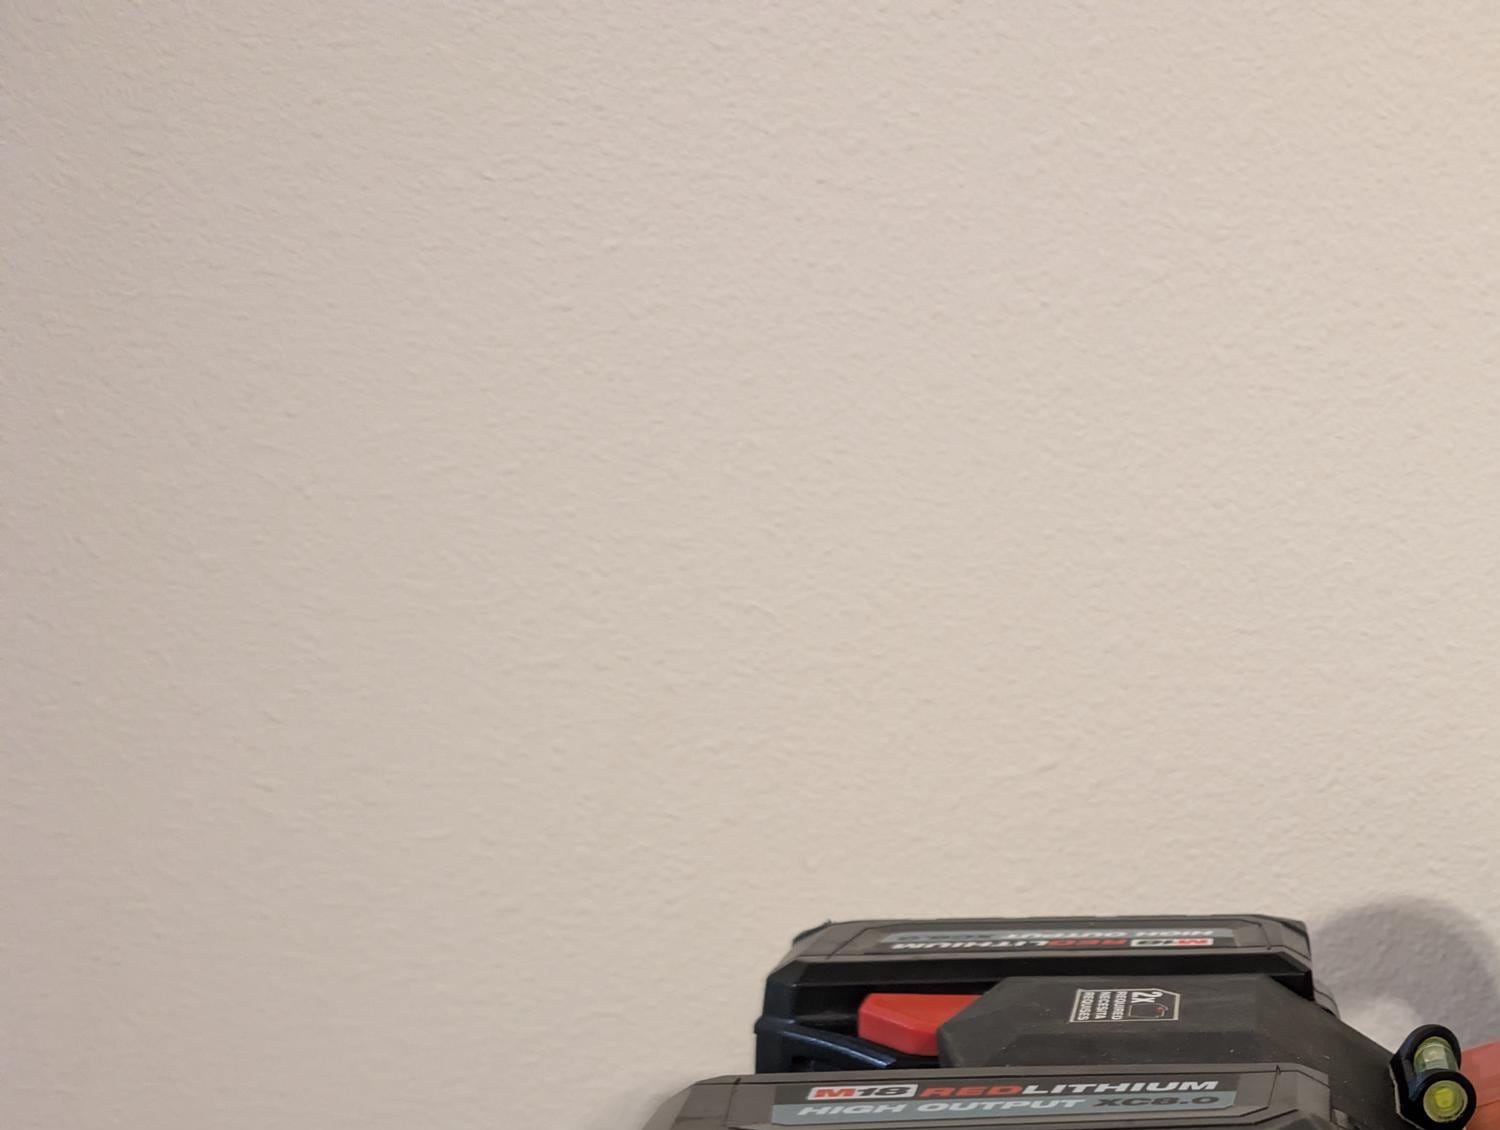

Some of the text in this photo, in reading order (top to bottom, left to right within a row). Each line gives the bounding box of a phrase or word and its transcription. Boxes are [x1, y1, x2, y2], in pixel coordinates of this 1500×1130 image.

[1095, 991, 1112, 1020] NECESITA
[1112, 991, 1128, 1020] REQUIRED
[813, 1087, 912, 1098] M18
[798, 1103, 908, 1115] HIGH
[917, 1098, 1087, 1112] OUTPUT
